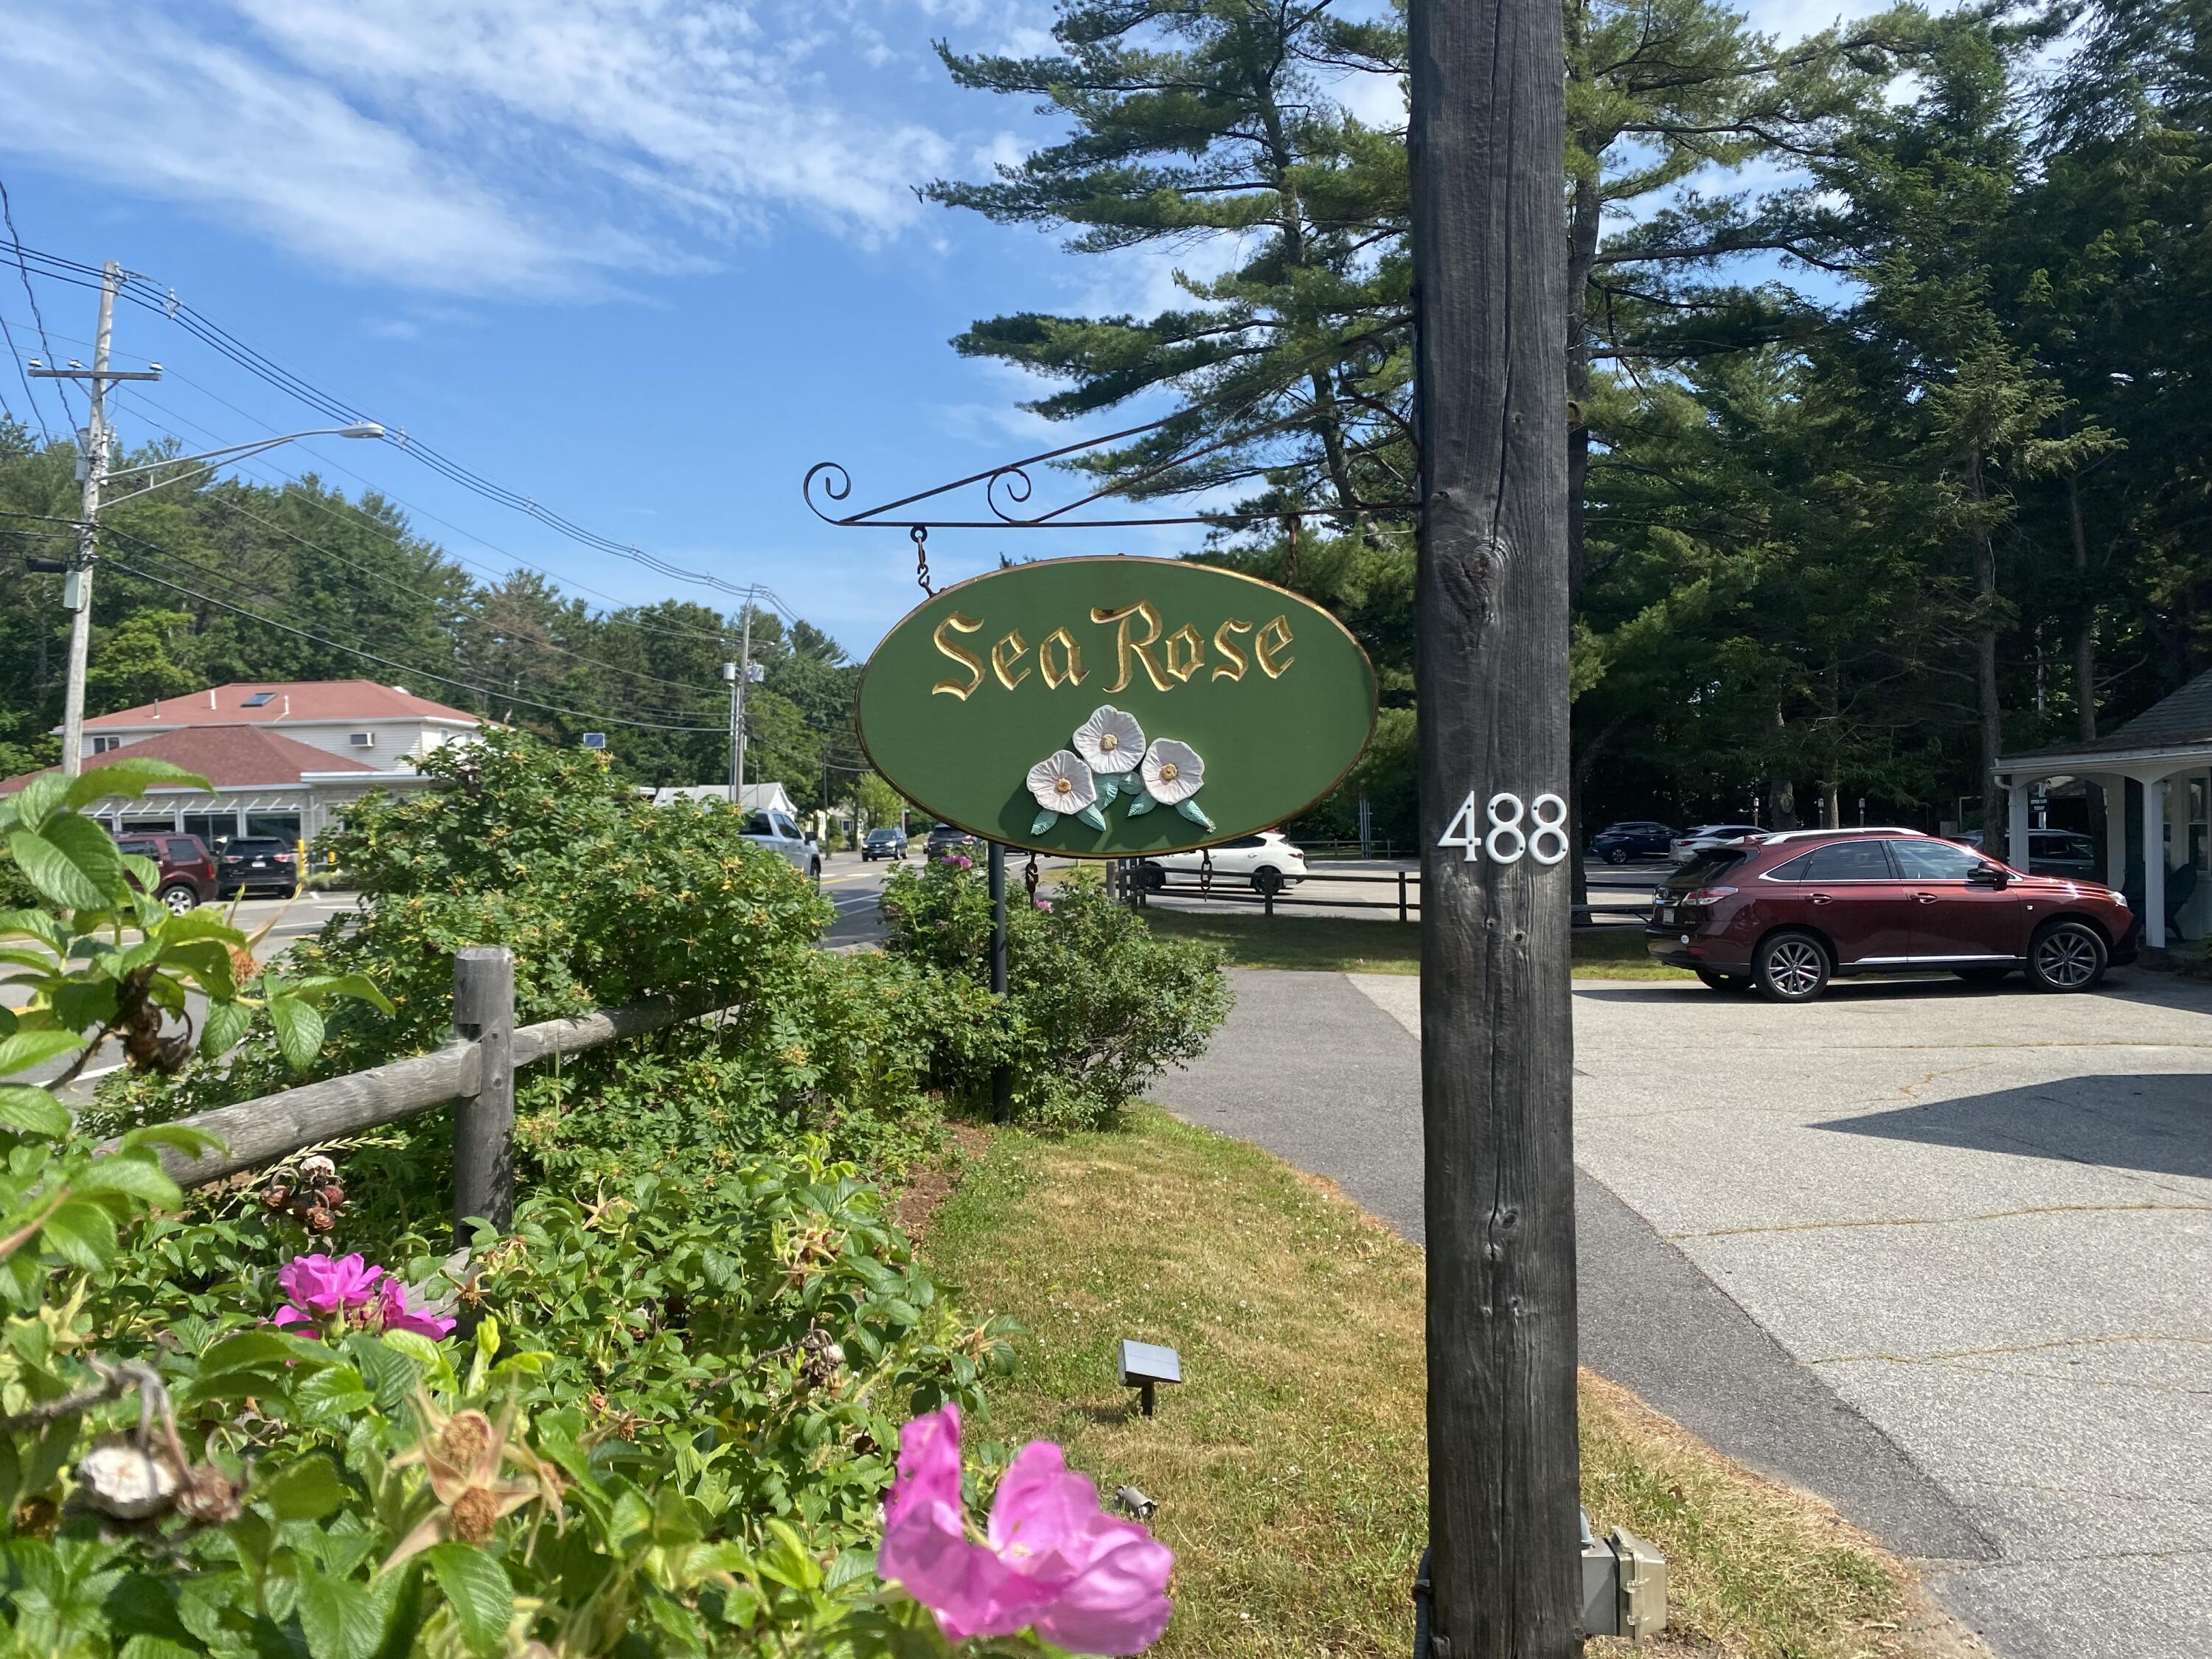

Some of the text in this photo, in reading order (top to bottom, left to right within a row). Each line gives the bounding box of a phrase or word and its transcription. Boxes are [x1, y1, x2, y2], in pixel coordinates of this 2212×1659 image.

[931, 599, 1296, 701] Sea Rose
[1437, 790, 1569, 866] 488
